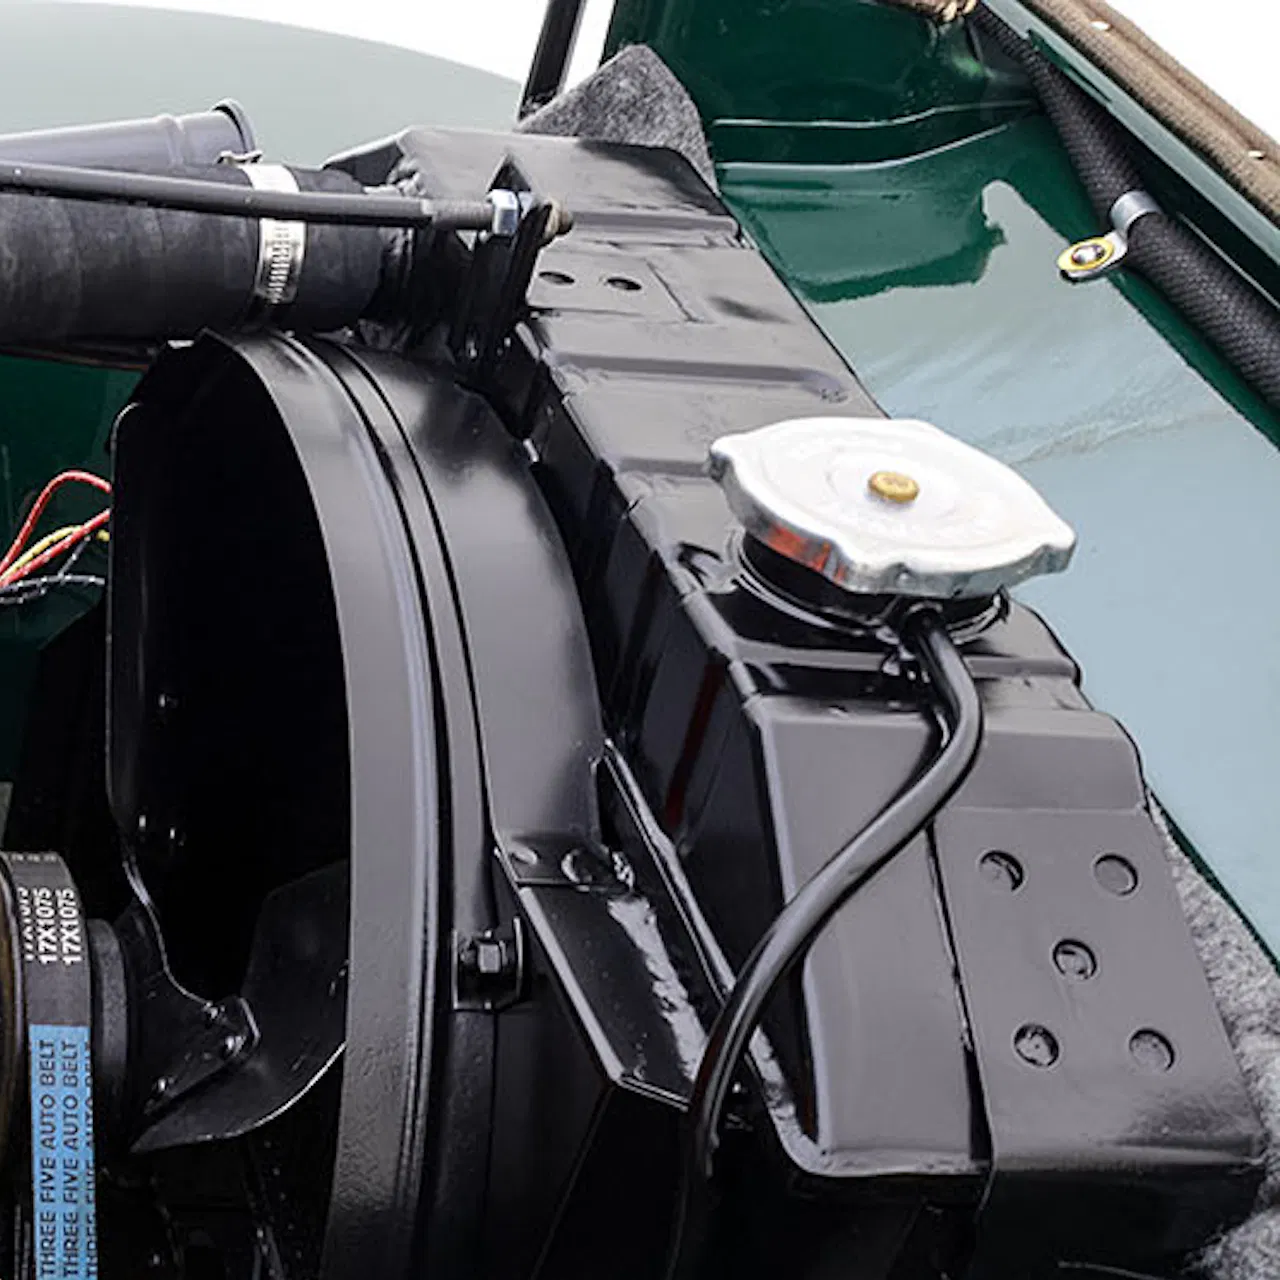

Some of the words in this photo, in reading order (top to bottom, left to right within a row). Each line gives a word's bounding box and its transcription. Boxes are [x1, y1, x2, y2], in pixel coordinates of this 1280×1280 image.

[32, 887, 58, 965] 17X1075
[55, 888, 82, 966] 17X1075
[39, 1040, 55, 1086] BELT
[62, 1041, 78, 1087] BELT
[40, 1094, 56, 1150] AUTO
[63, 1095, 79, 1150] AUTO
[40, 1157, 56, 1203] FIVE
[63, 1157, 79, 1203] FIVE
[40, 1211, 56, 1276] THREE
[63, 1211, 79, 1277] THREE
